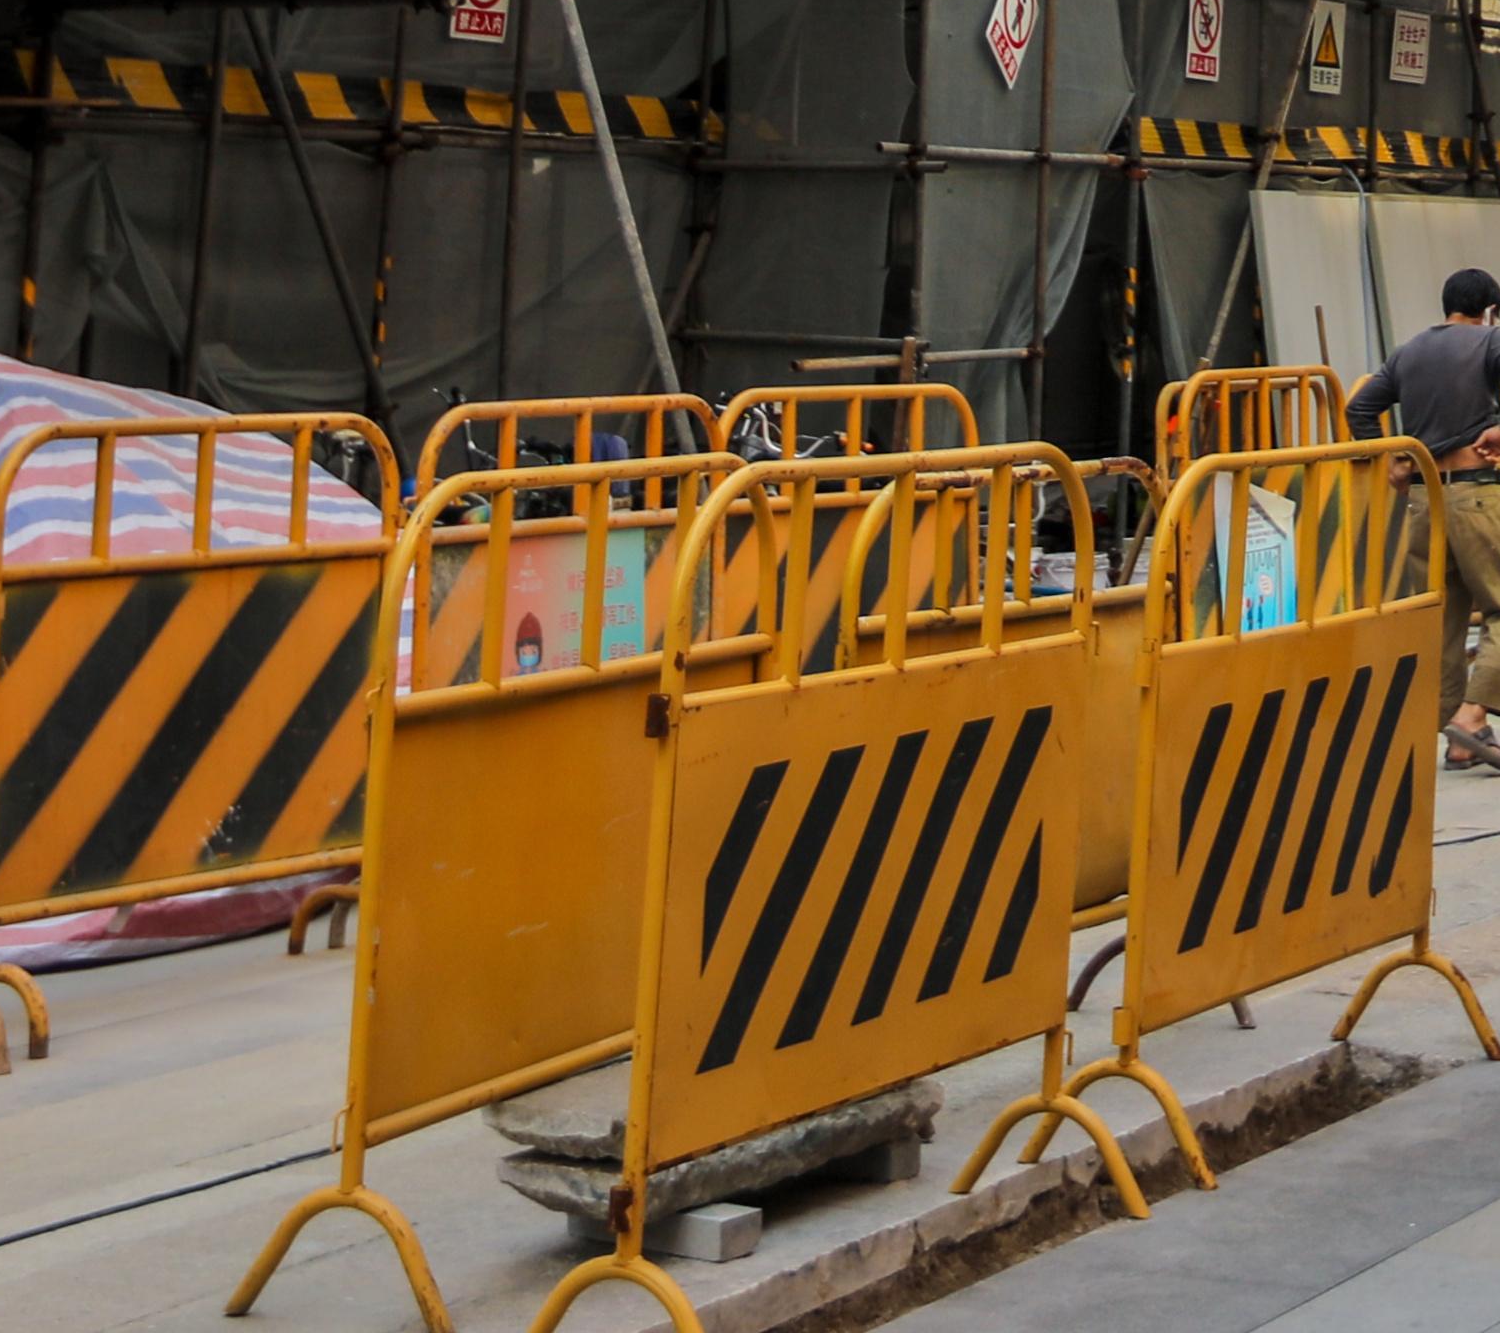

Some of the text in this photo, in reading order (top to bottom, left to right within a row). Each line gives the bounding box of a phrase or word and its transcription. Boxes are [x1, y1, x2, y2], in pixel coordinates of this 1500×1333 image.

[459, 11, 503, 35] 禁止入内
[1399, 24, 1427, 44] 安全生产
[1313, 69, 1339, 86] 注意安全
